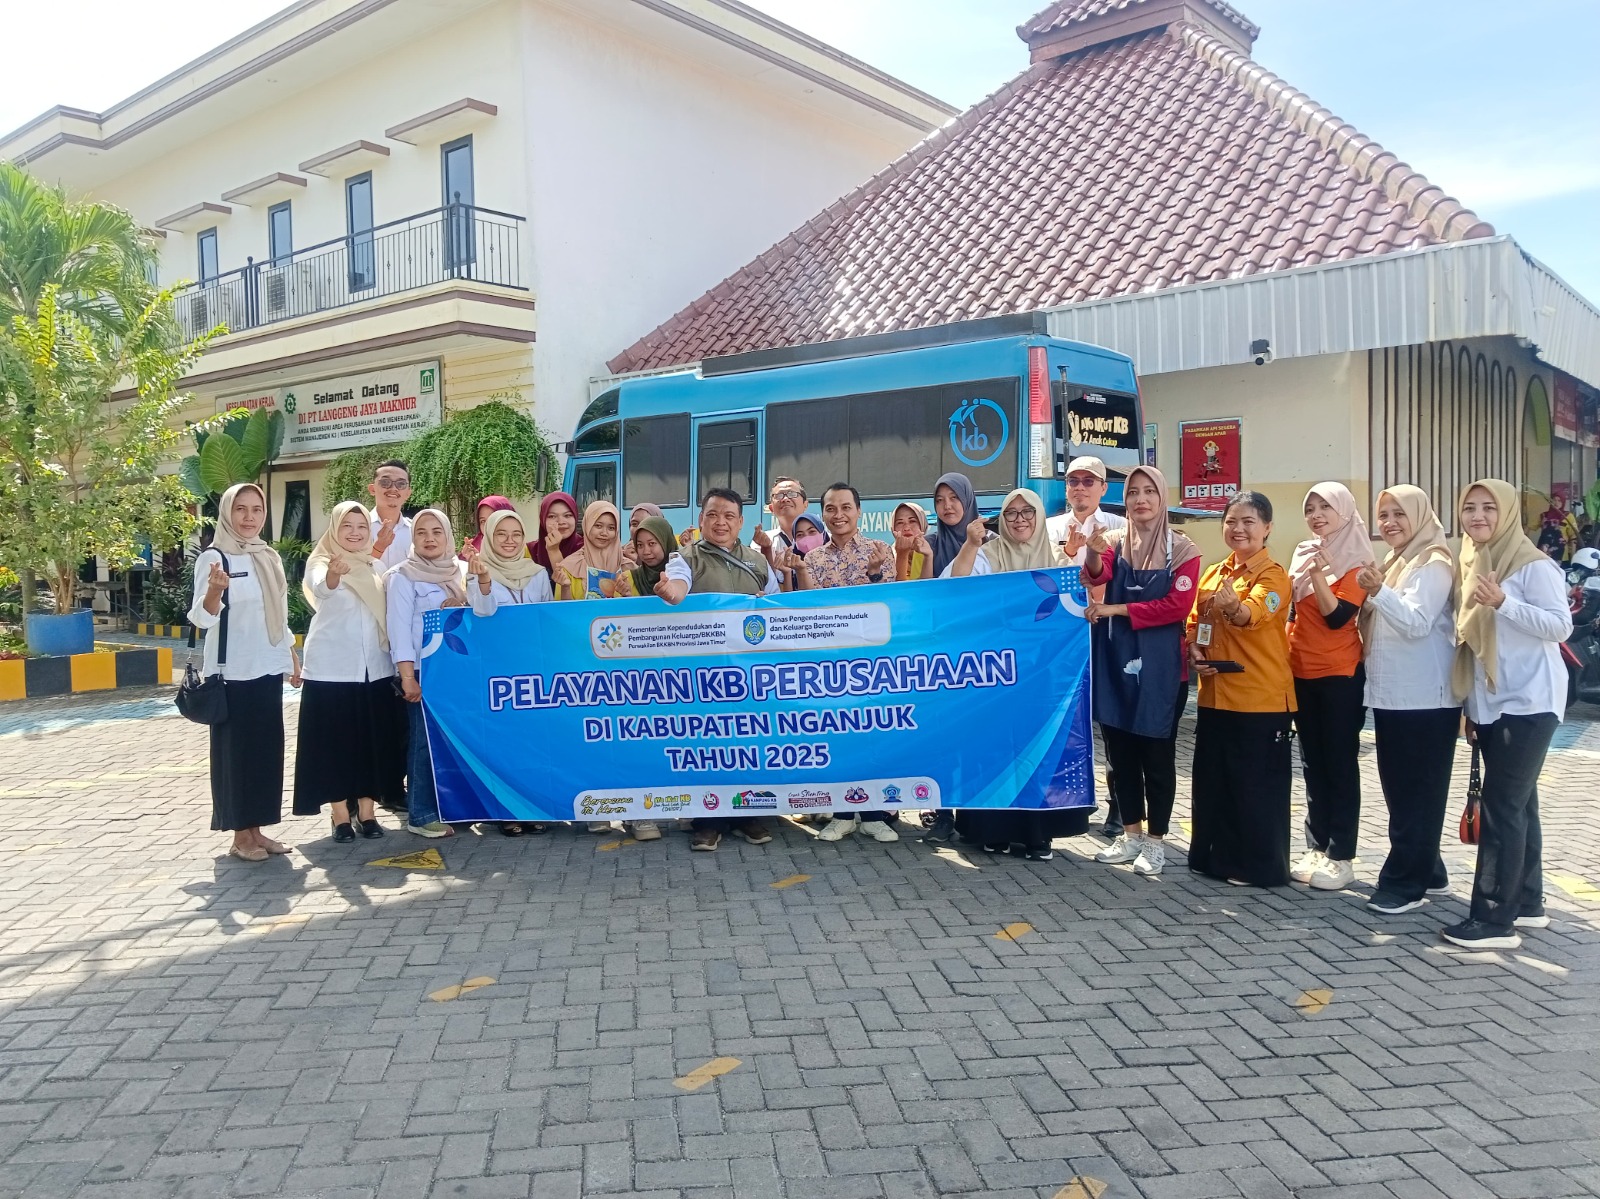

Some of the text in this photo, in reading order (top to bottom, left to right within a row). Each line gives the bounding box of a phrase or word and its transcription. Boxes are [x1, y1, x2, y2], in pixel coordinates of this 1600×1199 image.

[314, 383, 399, 405] Selamat Datang
[298, 397, 417, 424] DI PT LANGGENG JAYA MAKMUR
[344, 420, 372, 428] PERUSAHAAN
[387, 413, 421, 423] MENERAPKAN
[1113, 415, 1128, 434] KB
[340, 429, 371, 437] KESELAMATAN
[382, 423, 409, 432] KESEHATAN
[961, 426, 988, 451] kb
[1082, 431, 1118, 448] 2 Anak Cukup
[789, 614, 833, 622] Pengendalian
[834, 612, 868, 620] Penduduk
[627, 626, 666, 634] Kementerian
[667, 623, 712, 633] Kependudukan
[770, 630, 835, 641] Kabupaten Nganjuk
[783, 623, 812, 631] Keluarga
[628, 630, 726, 642] Pembangunan Keluarga/BKKBN
[489, 648, 1017, 711] PELAYANAN KB PERUSAHAAN
[584, 704, 918, 742] DI KABUPATEN NGANJUK
[666, 742, 830, 771] TAHUN 2025
